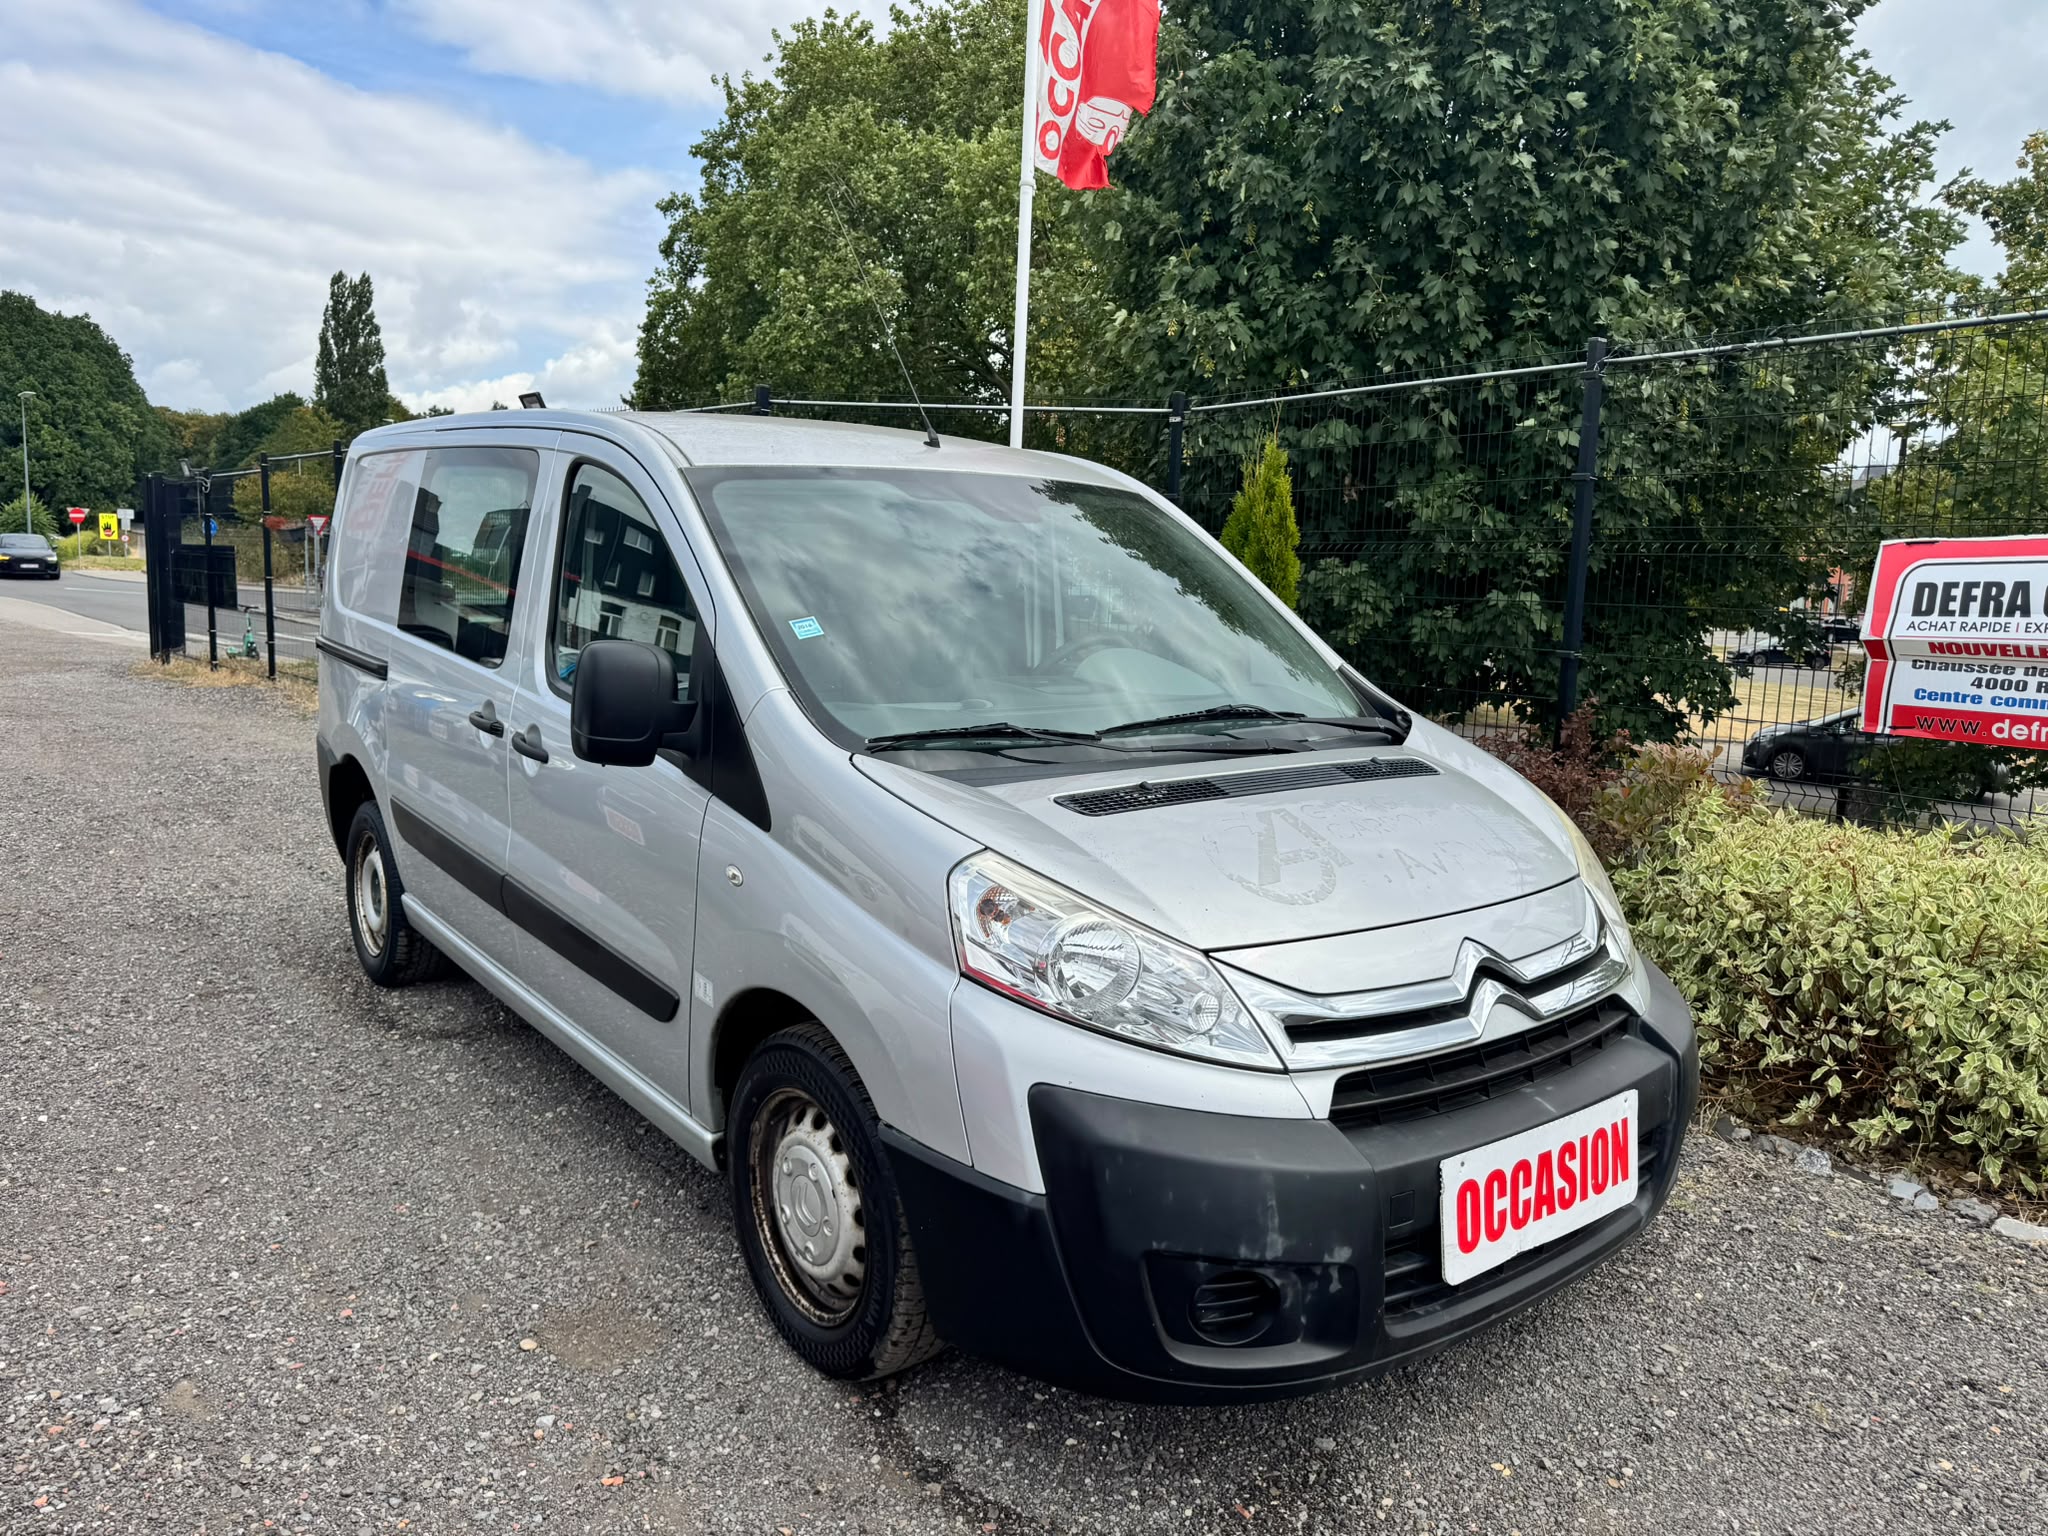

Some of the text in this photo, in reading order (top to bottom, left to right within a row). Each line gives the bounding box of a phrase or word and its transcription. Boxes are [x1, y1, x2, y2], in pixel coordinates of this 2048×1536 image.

[1039, 0, 1095, 160] OCCA
[1911, 581, 2031, 618] DEFRA
[1906, 620, 1957, 632] ACHAT
[1959, 621, 2012, 633] RAPIDE
[1928, 641, 2048, 659] NOUVELLE
[1911, 658, 2016, 675] Chaussée
[1970, 677, 2029, 692] 4000
[1914, 688, 1983, 705] Centre
[1456, 1116, 1630, 1255] OCCASION
